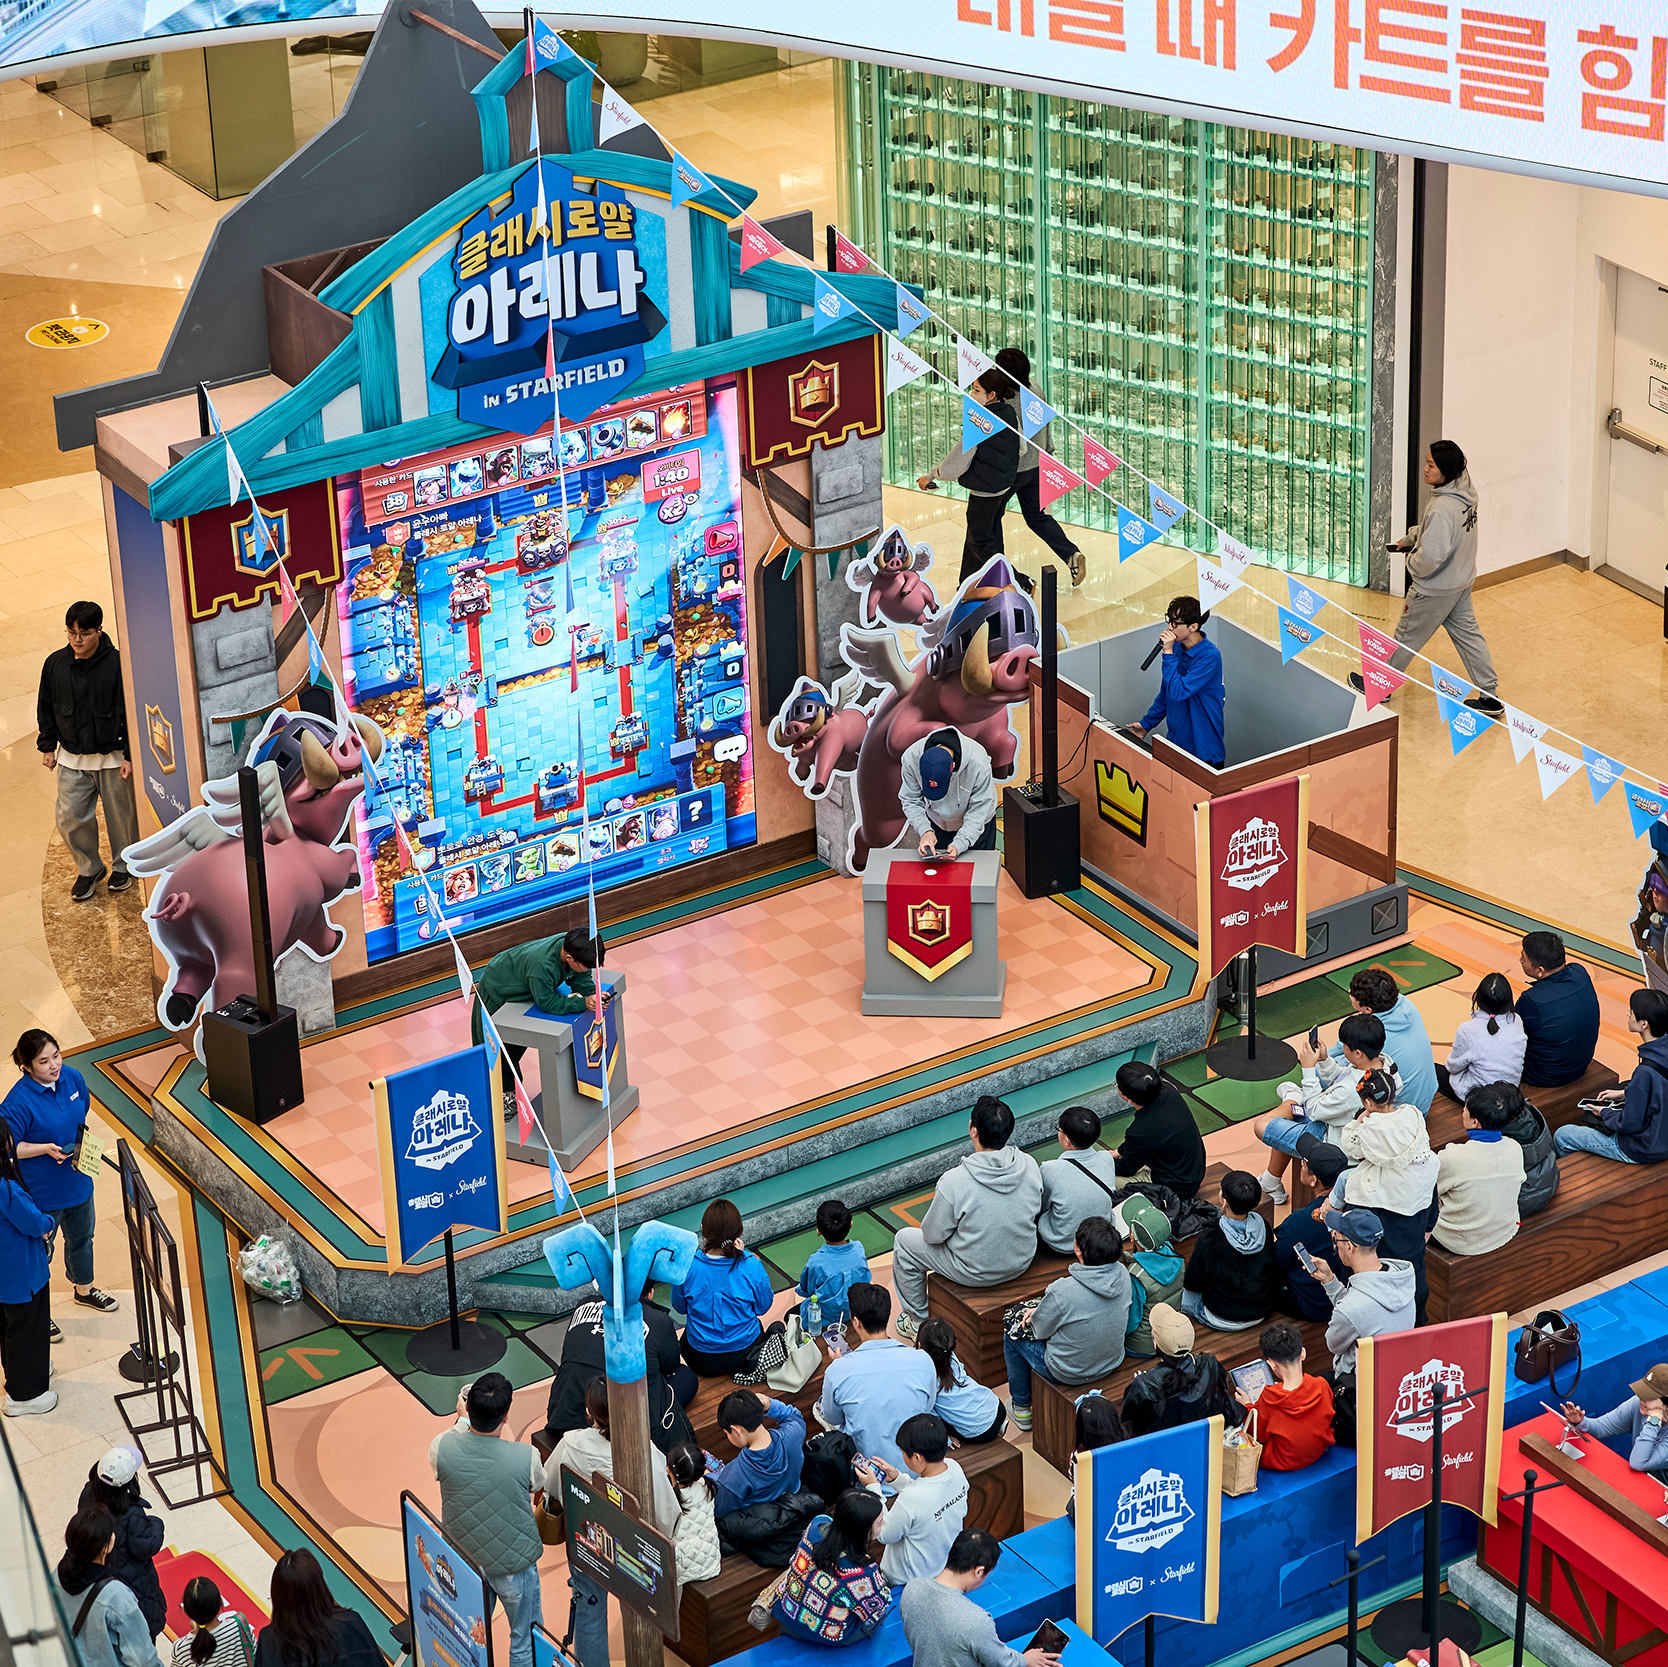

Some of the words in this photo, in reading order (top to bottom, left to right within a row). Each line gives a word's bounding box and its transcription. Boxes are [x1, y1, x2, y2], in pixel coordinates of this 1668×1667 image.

[1265, 0, 1550, 123] 카트를
[1577, 23, 1668, 142] 힘
[605, 101, 632, 126] Starfield
[458, 199, 633, 280] 클래시로얄
[452, 250, 644, 345] 아레나
[891, 351, 920, 375] Starfield
[1649, 357, 1668, 371] STAFF
[506, 357, 626, 404] STARFIELD
[398, 471, 414, 481] 카드
[653, 466, 690, 488] 1:40
[661, 484, 685, 498] Live
[457, 514, 483, 528] 아레나
[1201, 570, 1231, 592] Starfield
[1539, 753, 1571, 774] Starfield
[1230, 826, 1278, 850] 클래시로얄
[1228, 839, 1280, 866] 아레나
[1261, 900, 1289, 917] Starfield
[414, 1098, 468, 1127] 클래시로얄
[413, 1111, 473, 1145] 아레나
[432, 1143, 465, 1163] STARFIELD
[455, 1175, 488, 1195] Starfield
[1400, 1369, 1463, 1394] 클래시로얄
[1441, 1451, 1474, 1470] Starfield
[570, 1483, 591, 1505] Map
[1119, 1479, 1181, 1507] 클래시로얄
[1117, 1493, 1186, 1526] 아레나
[1135, 1527, 1174, 1544] STARFIELD
[436, 1562, 456, 1592] 아레나
[1160, 1561, 1196, 1583] Starfield
